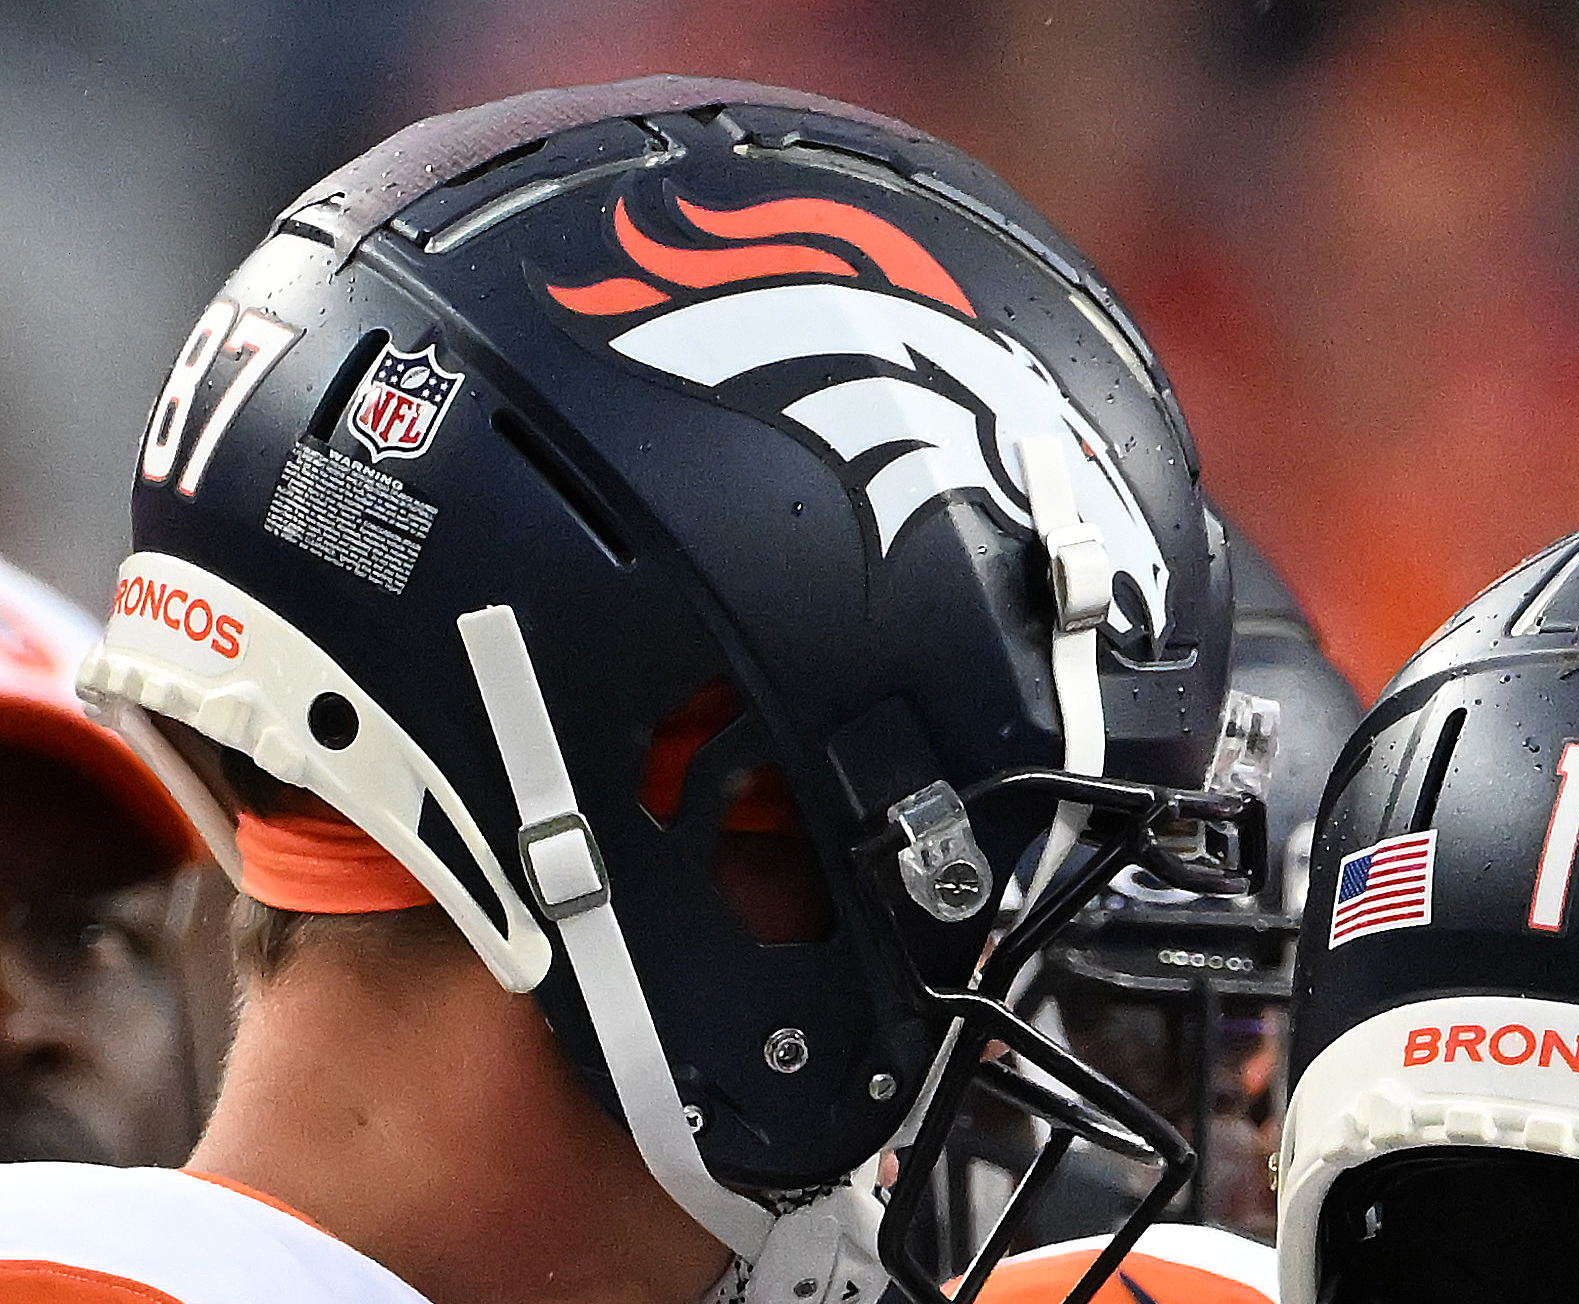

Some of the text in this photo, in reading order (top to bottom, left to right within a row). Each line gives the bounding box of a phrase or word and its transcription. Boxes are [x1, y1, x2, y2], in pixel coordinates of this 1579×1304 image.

[142, 300, 299, 497] 87
[360, 386, 428, 444] NFL
[330, 449, 403, 491] WARNING
